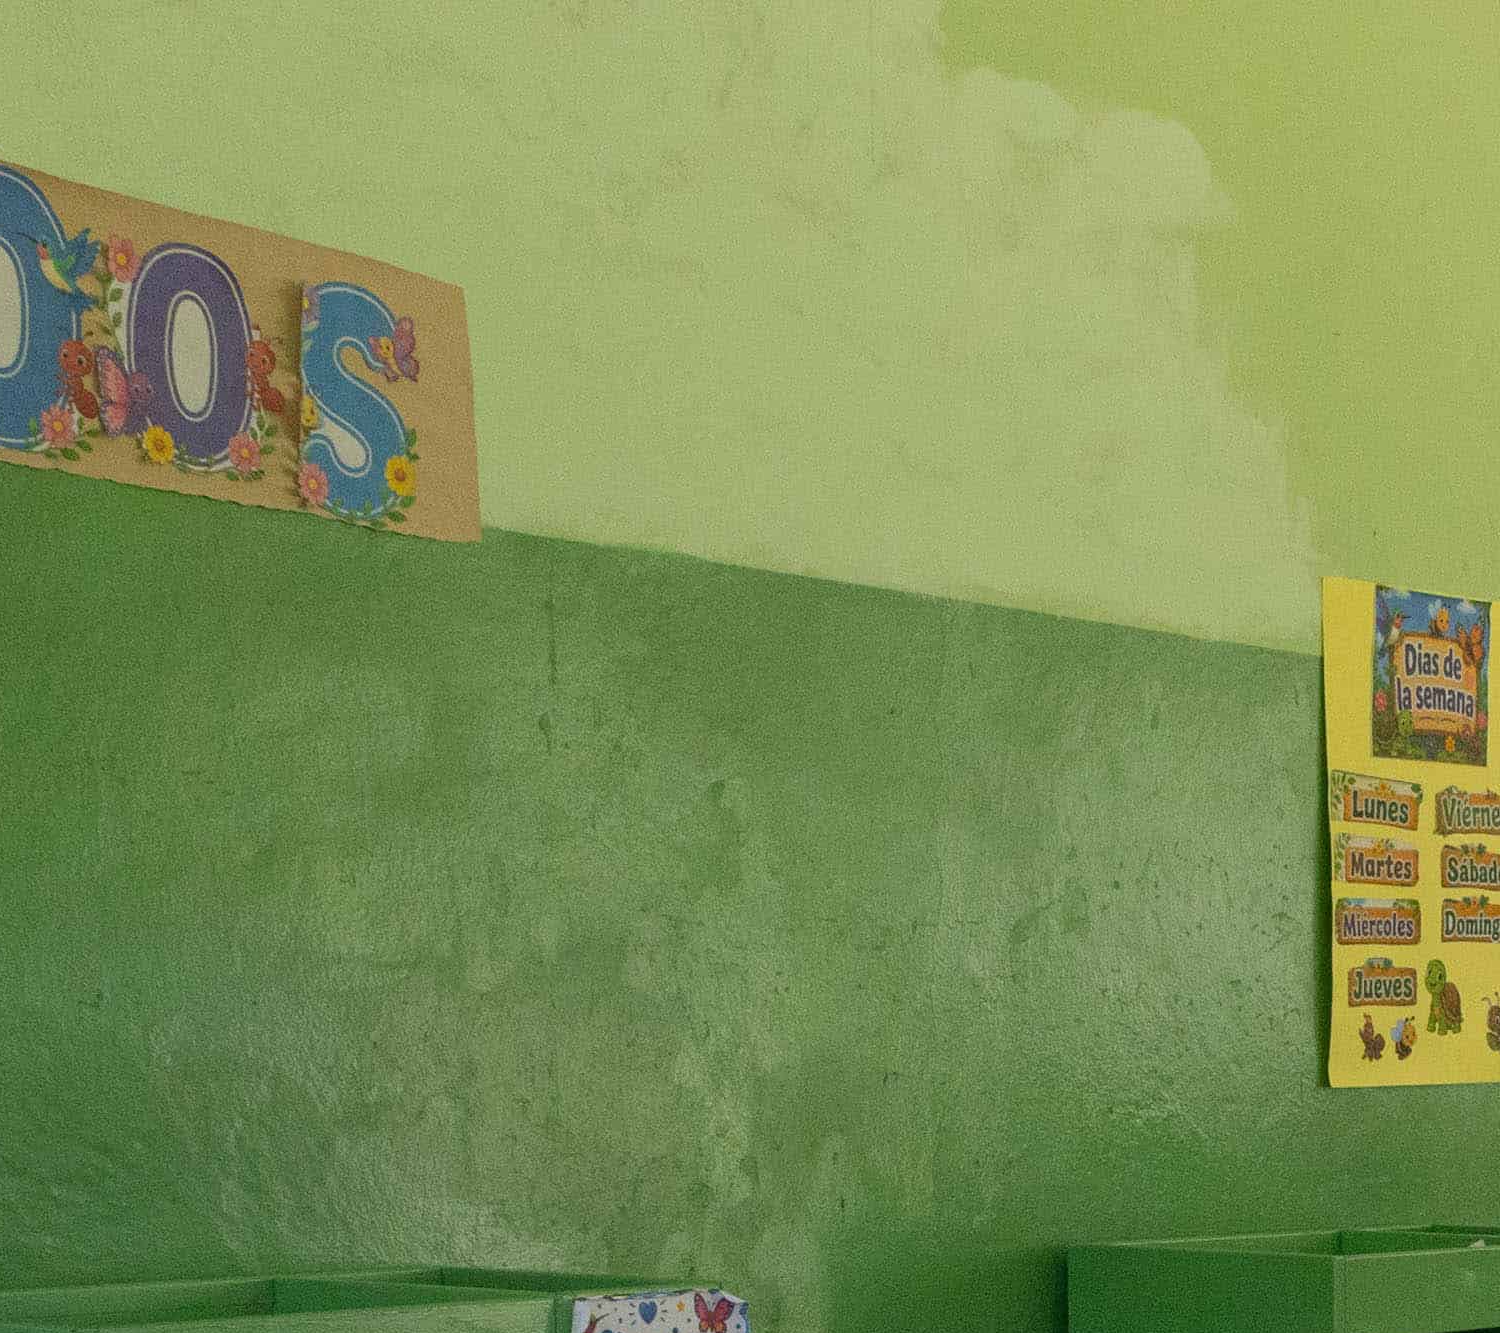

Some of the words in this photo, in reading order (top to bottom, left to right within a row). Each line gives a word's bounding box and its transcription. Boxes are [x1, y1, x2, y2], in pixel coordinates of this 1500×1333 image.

[1443, 648, 1463, 681] de
[1395, 676, 1414, 711] la
[1415, 685, 1475, 718] semana
[1351, 789, 1410, 825] Lunes
[1351, 851, 1413, 880] Martes
[1352, 970, 1415, 1000] Jueves
